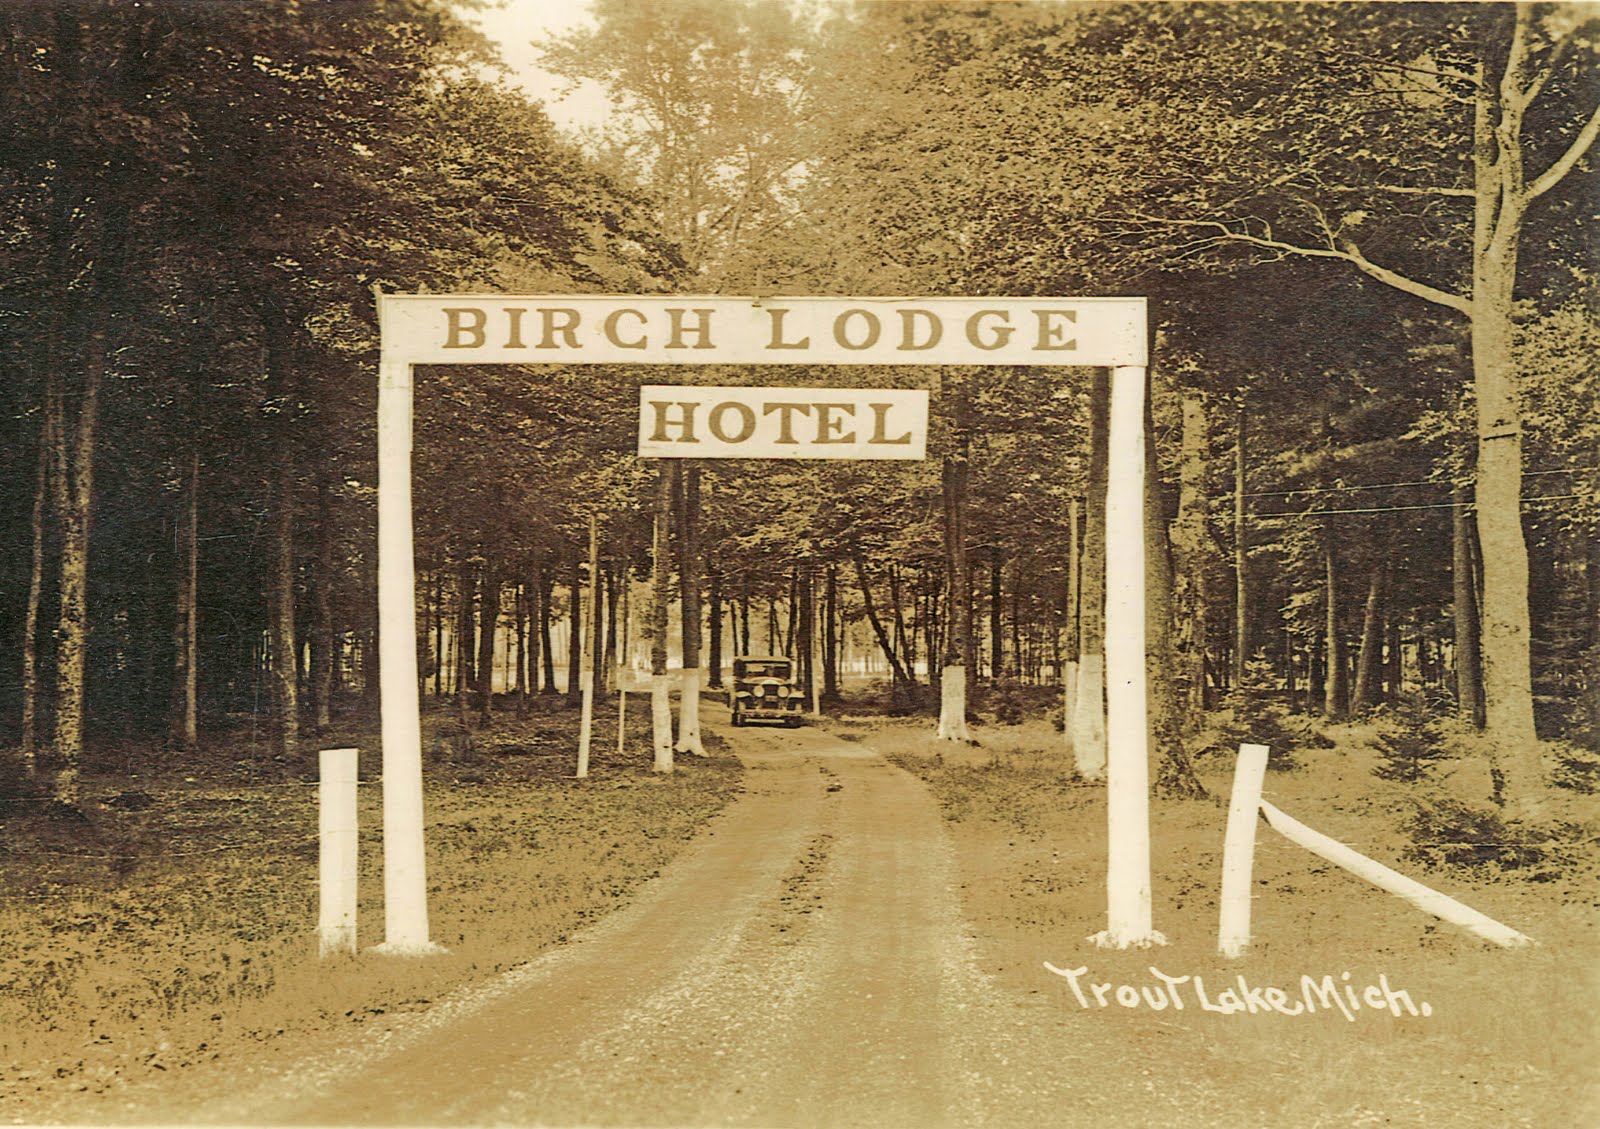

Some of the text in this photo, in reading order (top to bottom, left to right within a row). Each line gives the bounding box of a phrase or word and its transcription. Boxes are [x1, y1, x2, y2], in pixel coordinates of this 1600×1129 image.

[442, 307, 1078, 351] BIRCH LODGE
[648, 401, 912, 444] HOTEL
